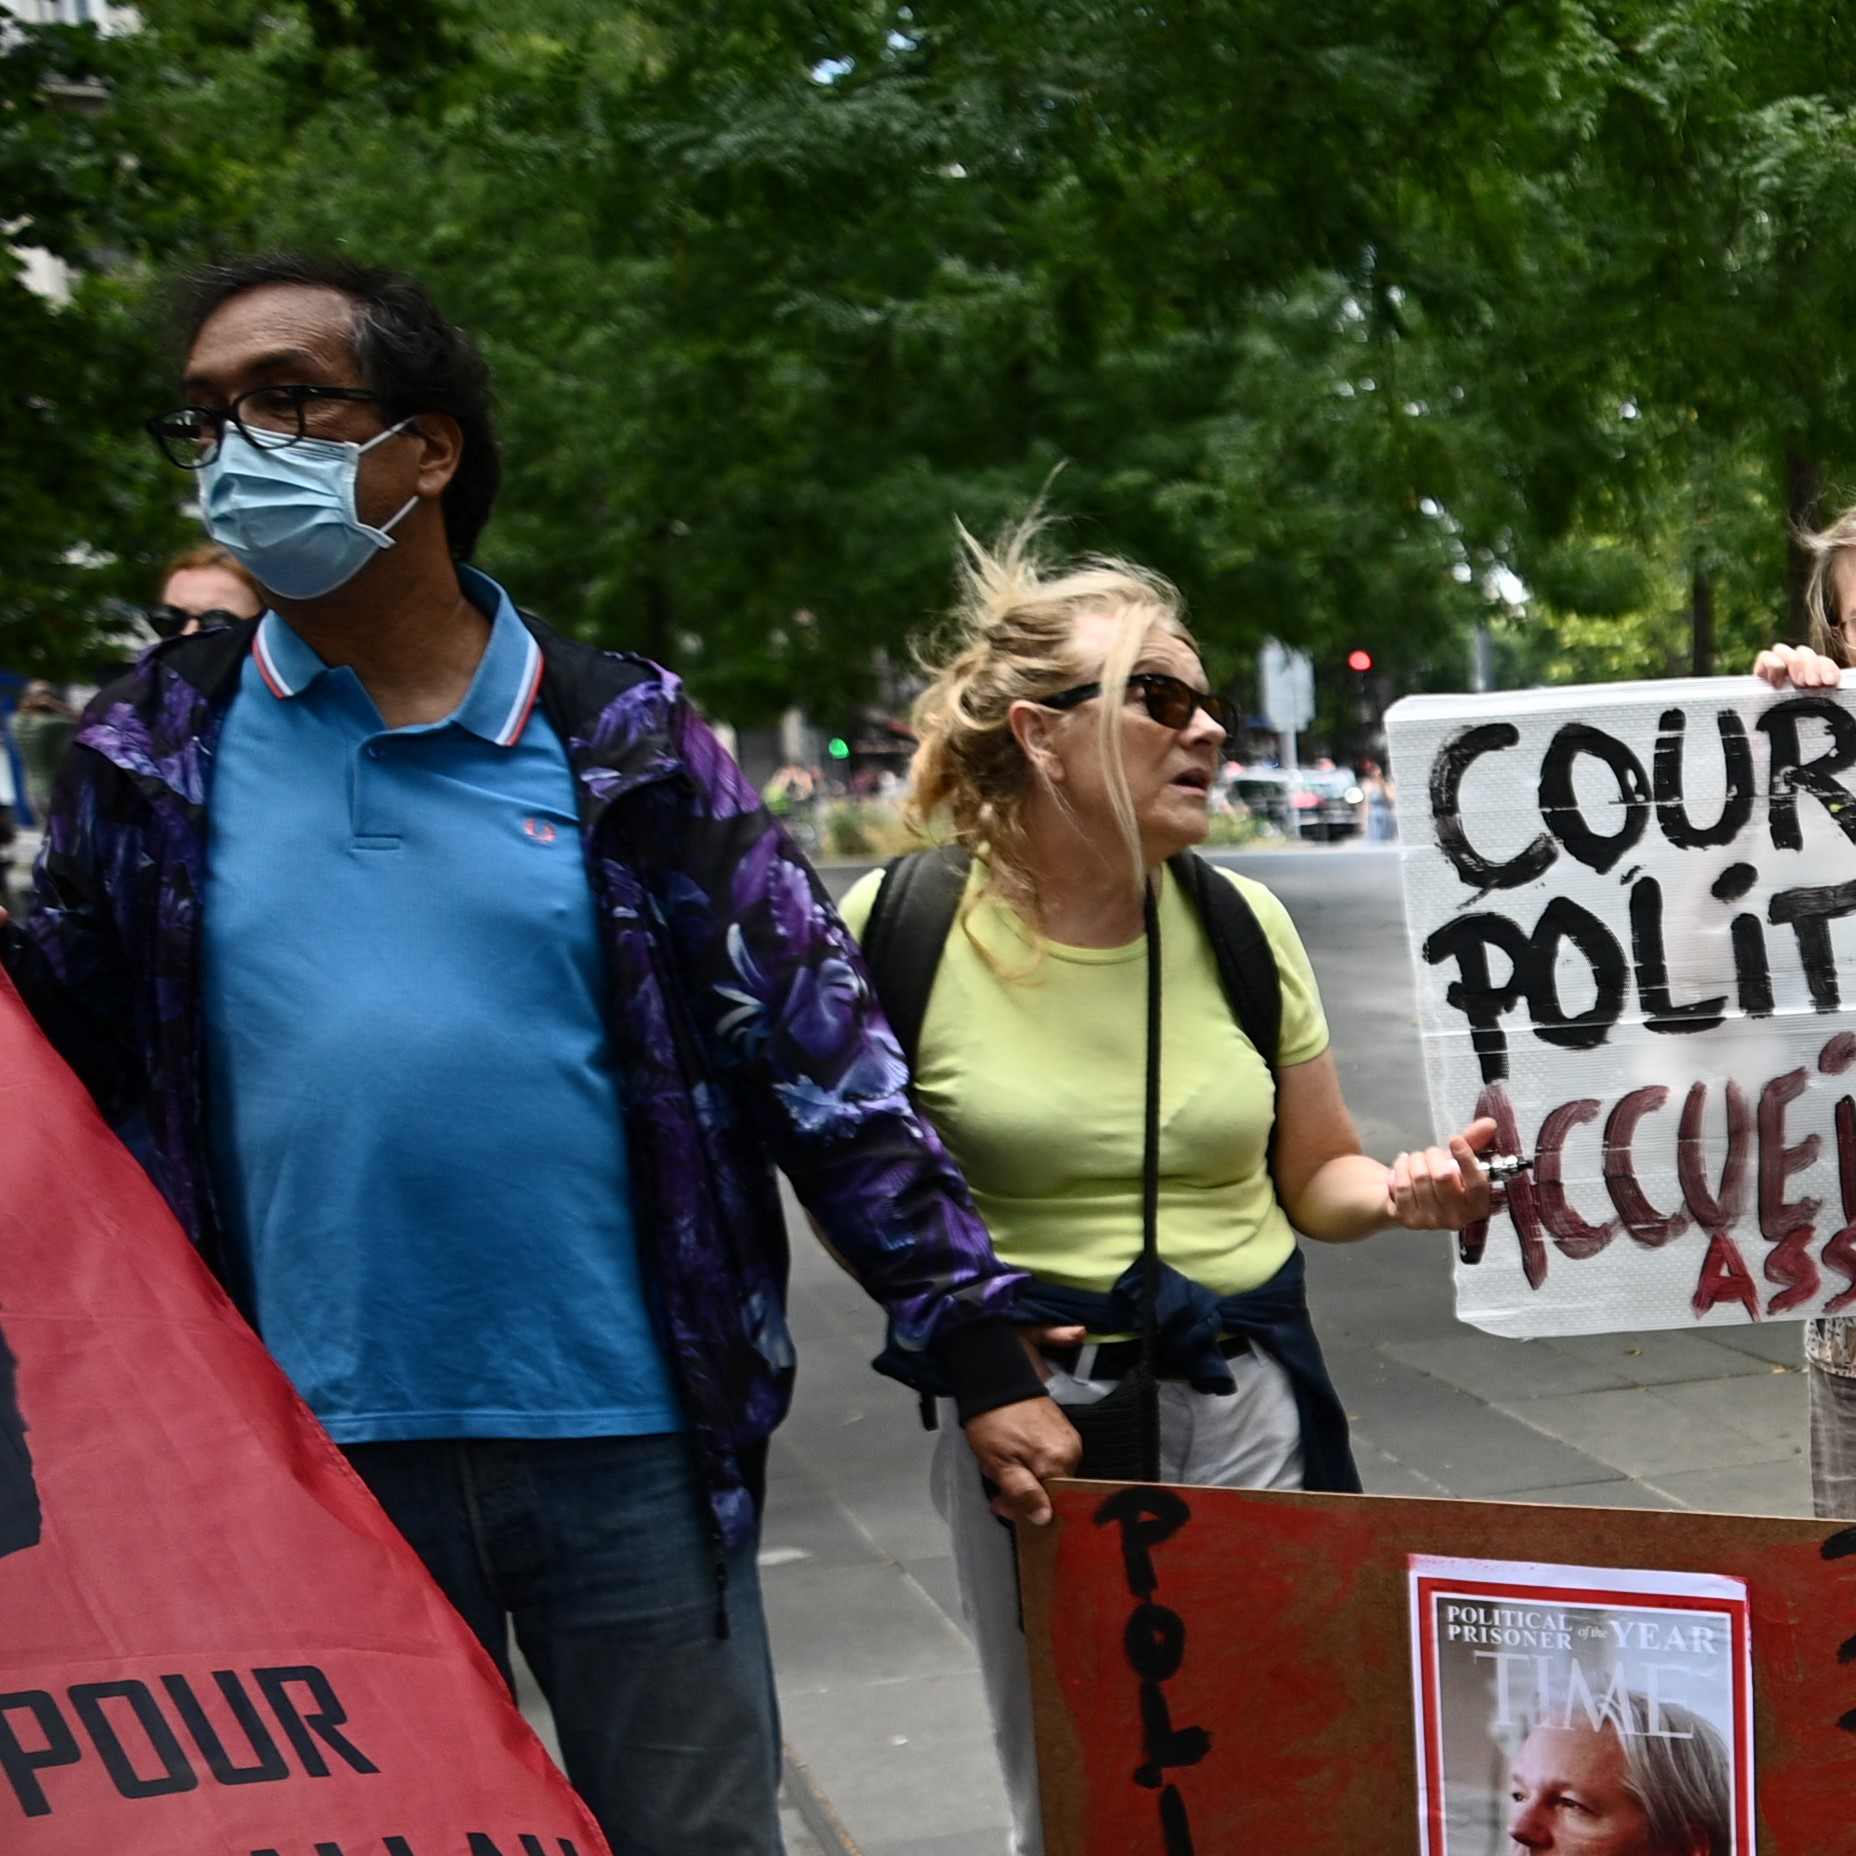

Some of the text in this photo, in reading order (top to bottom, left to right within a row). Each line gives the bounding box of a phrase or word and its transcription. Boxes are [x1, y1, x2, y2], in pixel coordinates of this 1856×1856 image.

[1448, 1605, 1574, 1632] POLITICAL
[1448, 1624, 1574, 1650] PRISONER
[1608, 1620, 1719, 1656] YEAR
[1473, 1650, 1717, 1740] TIME
[0, 1665, 381, 1818] POUR
